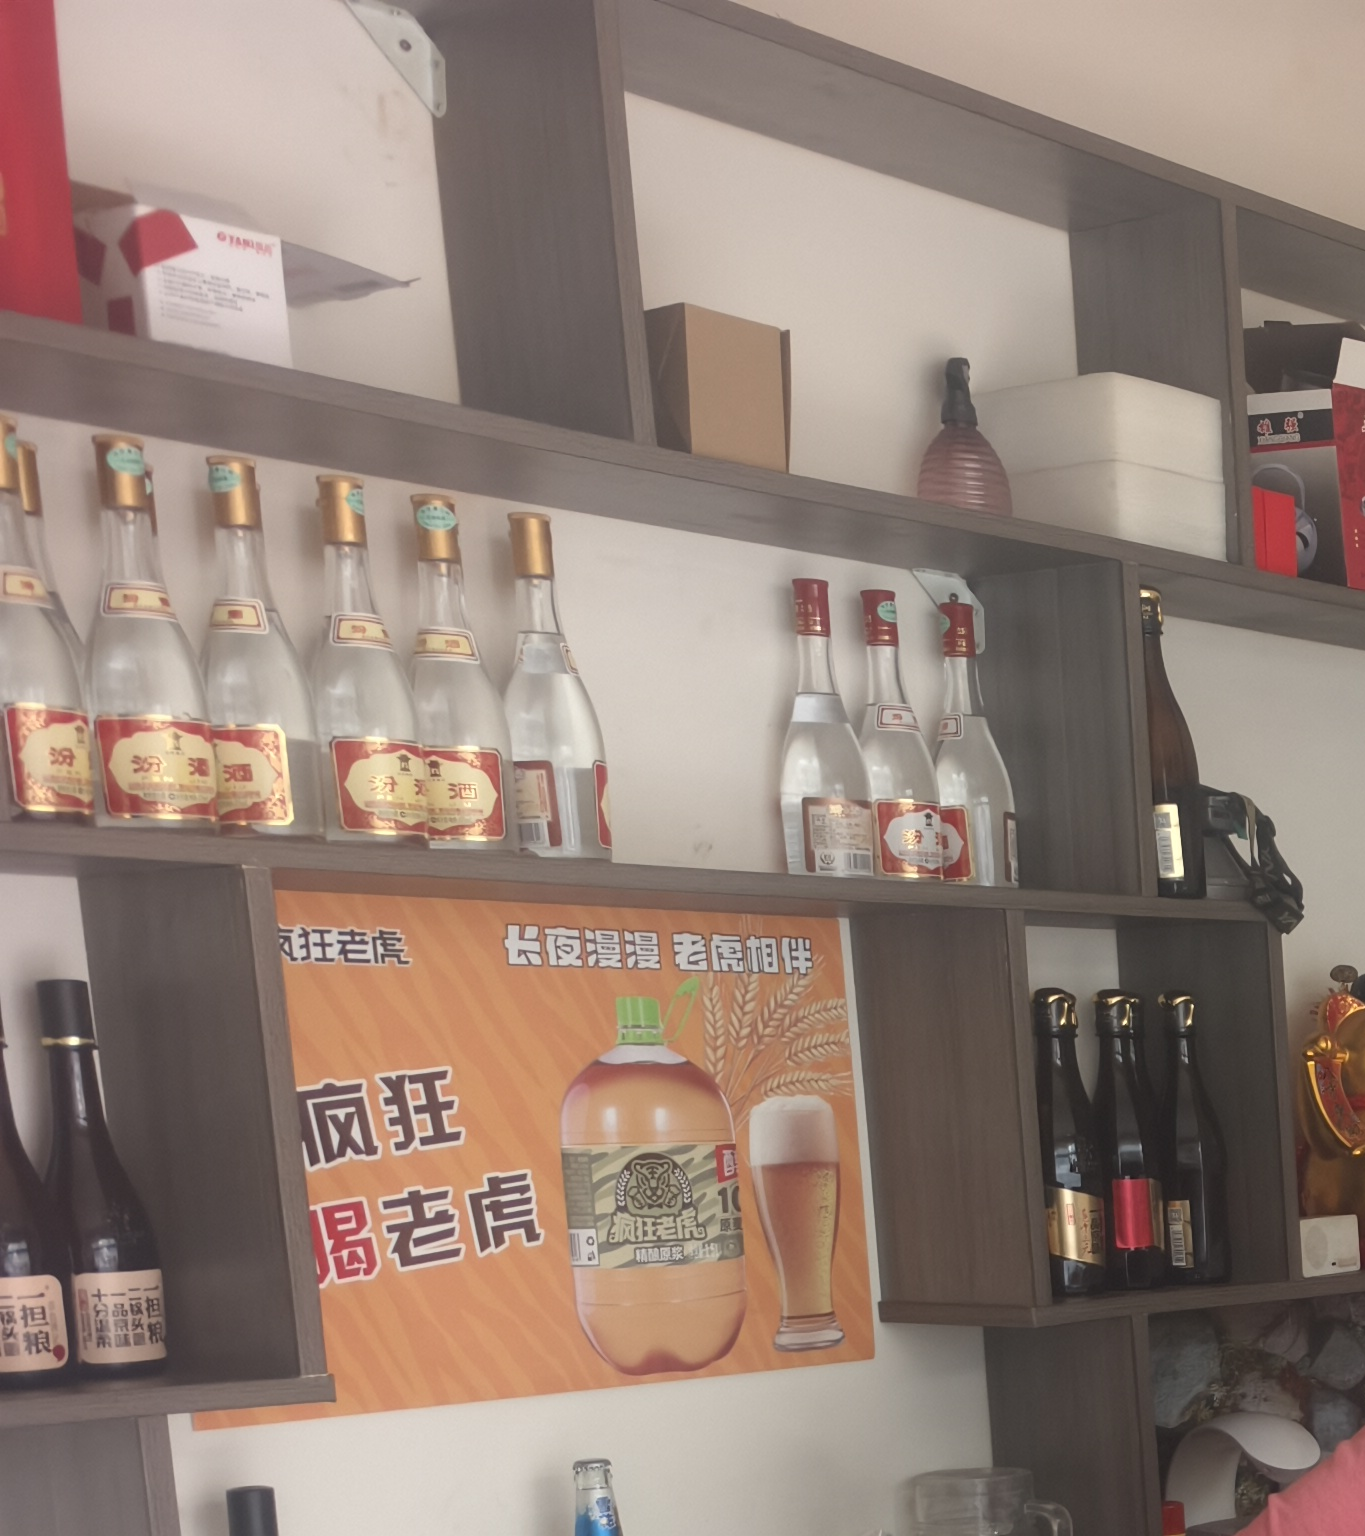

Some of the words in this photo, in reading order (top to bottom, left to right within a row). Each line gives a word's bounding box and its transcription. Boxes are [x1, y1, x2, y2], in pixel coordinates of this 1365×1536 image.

[504, 923, 662, 972] 长夜漫漫
[673, 931, 815, 976] 老虎相伴
[297, 1066, 466, 1169] 疯狂
[607, 1207, 709, 1246] 疯狂老虎
[634, 1245, 685, 1264] 精酿原浆
